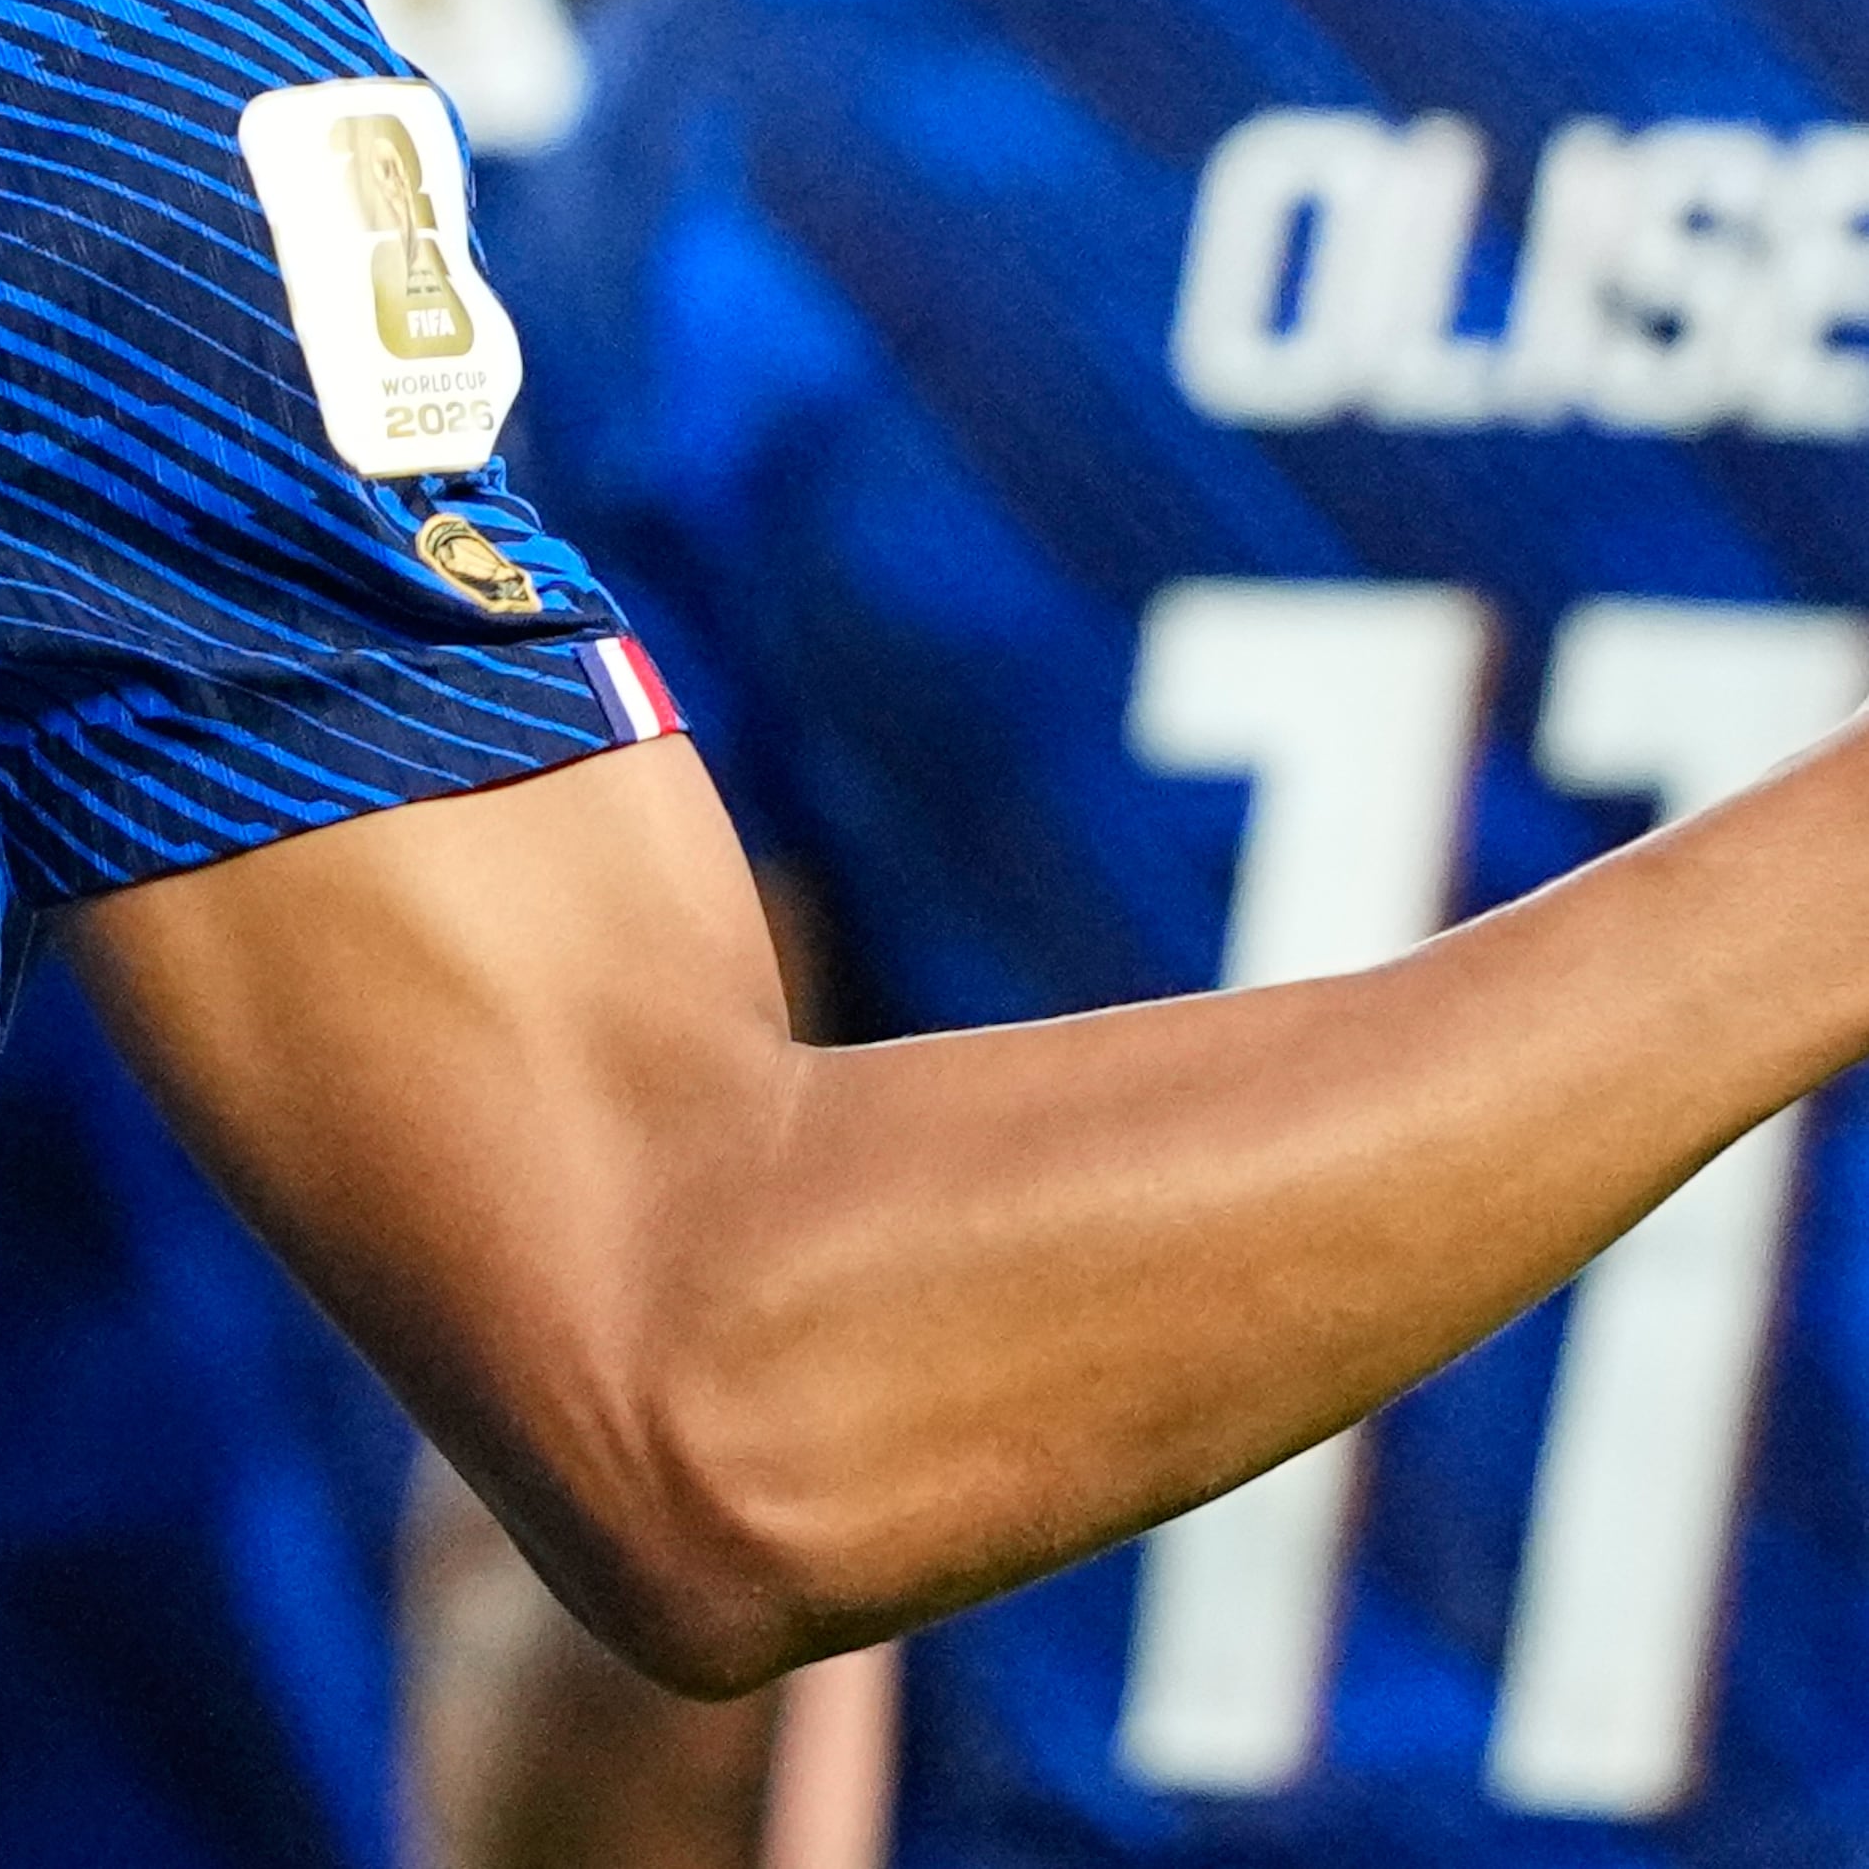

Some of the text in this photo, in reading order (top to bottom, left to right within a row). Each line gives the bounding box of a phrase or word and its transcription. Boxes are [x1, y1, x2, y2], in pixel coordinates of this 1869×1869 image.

[406, 308, 457, 338] FIFA
[382, 371, 487, 397] WORLD CUP
[385, 400, 494, 439] 2026
[1118, 576, 1869, 1818] 11
